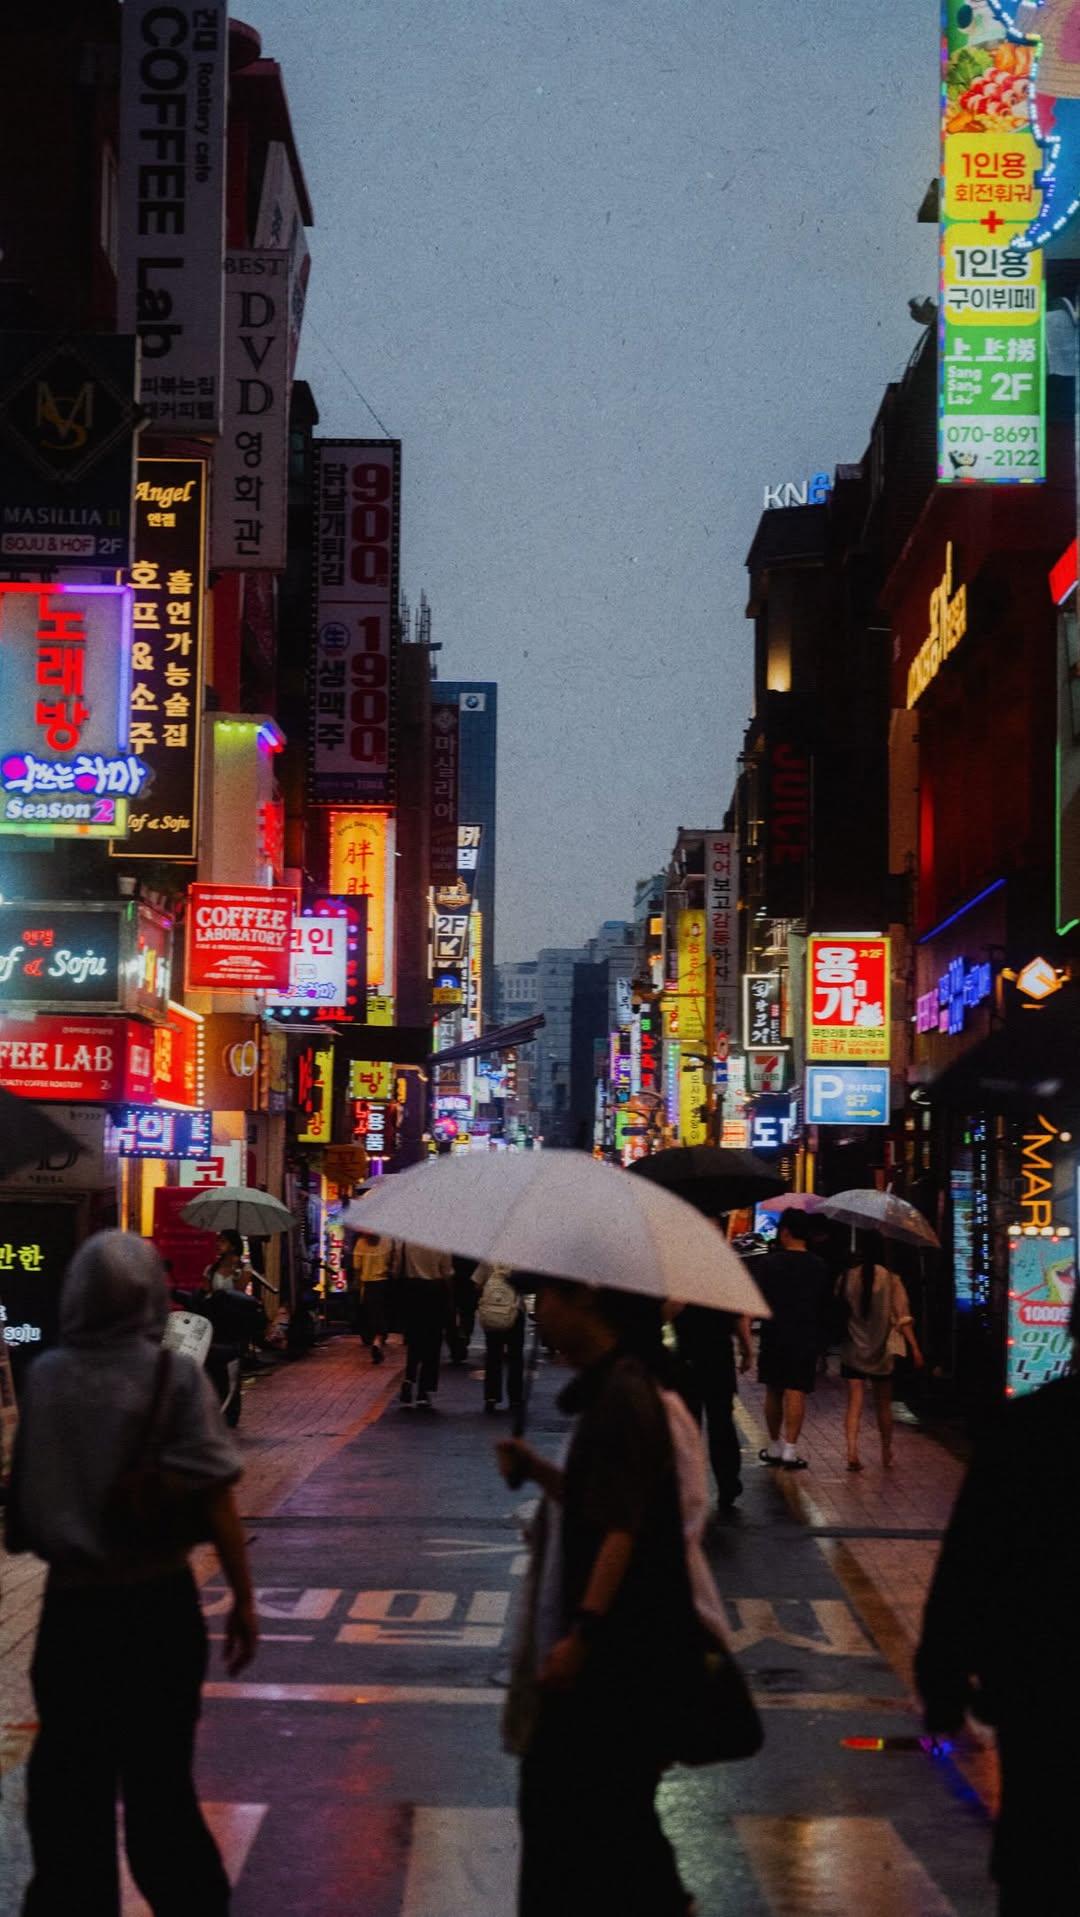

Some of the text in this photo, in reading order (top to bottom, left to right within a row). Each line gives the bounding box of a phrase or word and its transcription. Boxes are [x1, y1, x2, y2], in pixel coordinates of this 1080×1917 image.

[961, 152, 1027, 180] 1인용
[135, 7, 188, 359] COFFEE Lab
[223, 257, 284, 276] BEST
[955, 249, 1029, 279] 1인용
[236, 291, 276, 416] DVD
[990, 371, 1034, 402] 2F
[946, 425, 1039, 444] 070-8691
[134, 480, 197, 509] Angel
[233, 431, 264, 557] 영화관
[3, 506, 103, 526] MASILLIA
[351, 463, 391, 585] 900
[5, 536, 125, 555] SOJU & HOF 2F
[35, 592, 89, 753] 노래방
[126, 560, 161, 755] 호프&소주
[162, 569, 195, 748] 흡연가능술집
[350, 615, 388, 763] 1900
[5, 797, 116, 823] Season 2
[771, 744, 810, 867] JUICE
[195, 906, 288, 931] COFFEE
[437, 917, 466, 935] 2F
[195, 928, 288, 947] LABORATORY
[48, 949, 109, 984] Soju
[813, 946, 860, 1022] 용가
[54, 1043, 113, 1072] LAB
[812, 1074, 844, 1117] P
